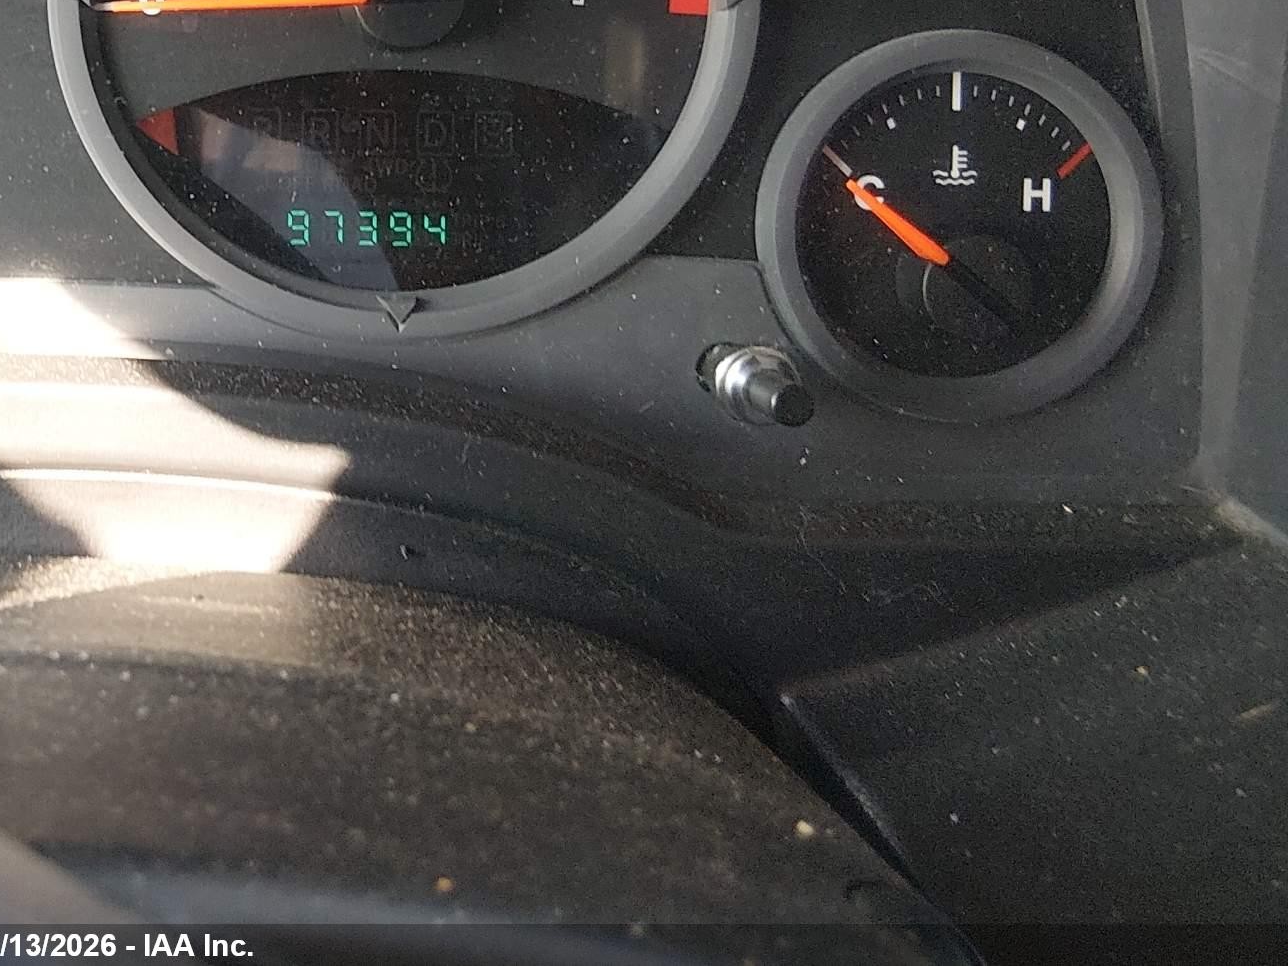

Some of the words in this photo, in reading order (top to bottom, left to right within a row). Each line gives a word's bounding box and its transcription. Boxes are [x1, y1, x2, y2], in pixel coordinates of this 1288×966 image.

[853, 174, 885, 211] C
[1022, 177, 1051, 212] H
[287, 209, 449, 247] 97394
